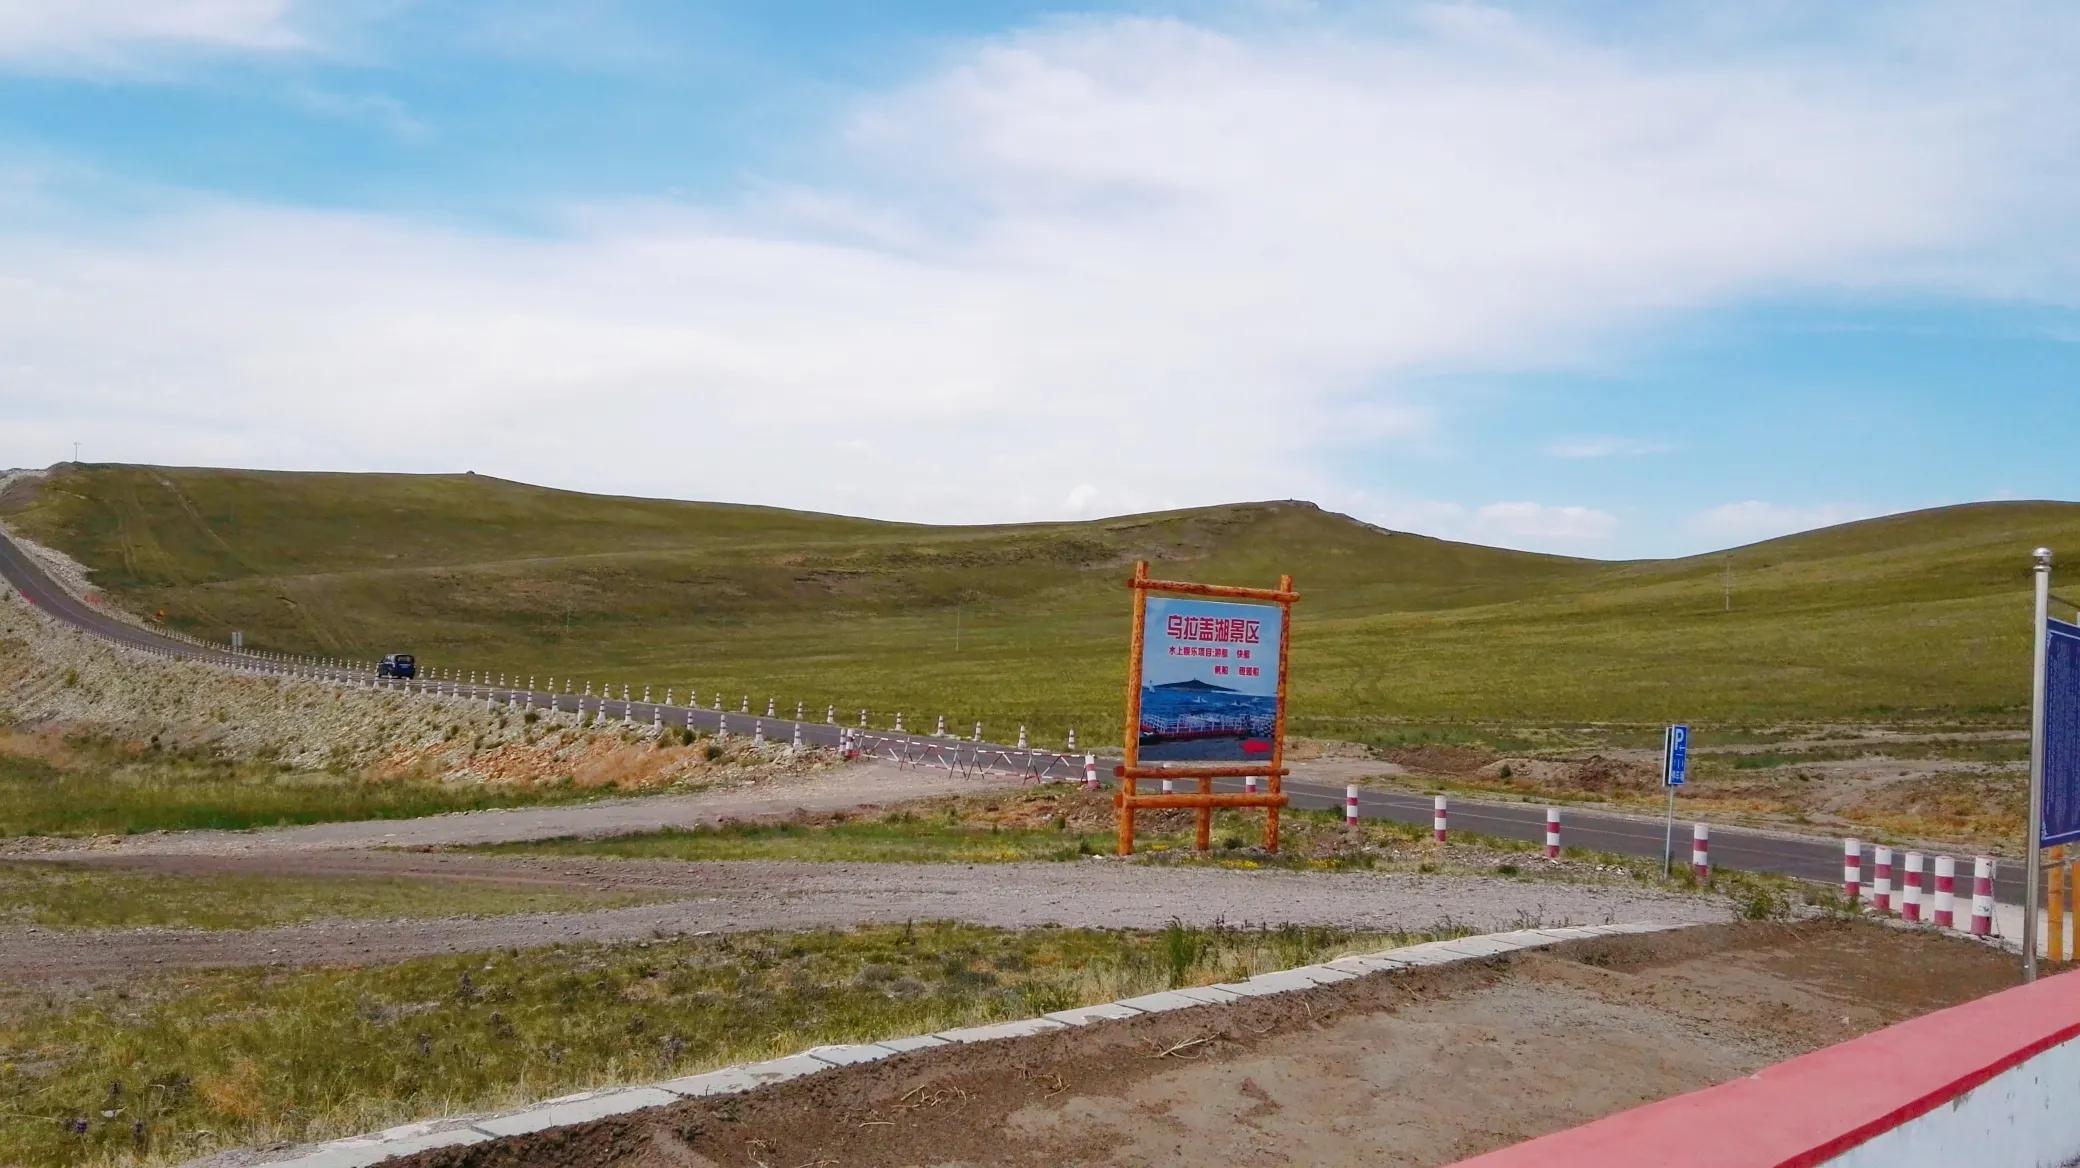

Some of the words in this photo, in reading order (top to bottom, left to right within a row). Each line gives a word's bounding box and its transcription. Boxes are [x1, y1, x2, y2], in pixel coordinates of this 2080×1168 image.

[1167, 615, 1260, 643] 乌拉盖湖景区
[1675, 728, 1684, 750] P
